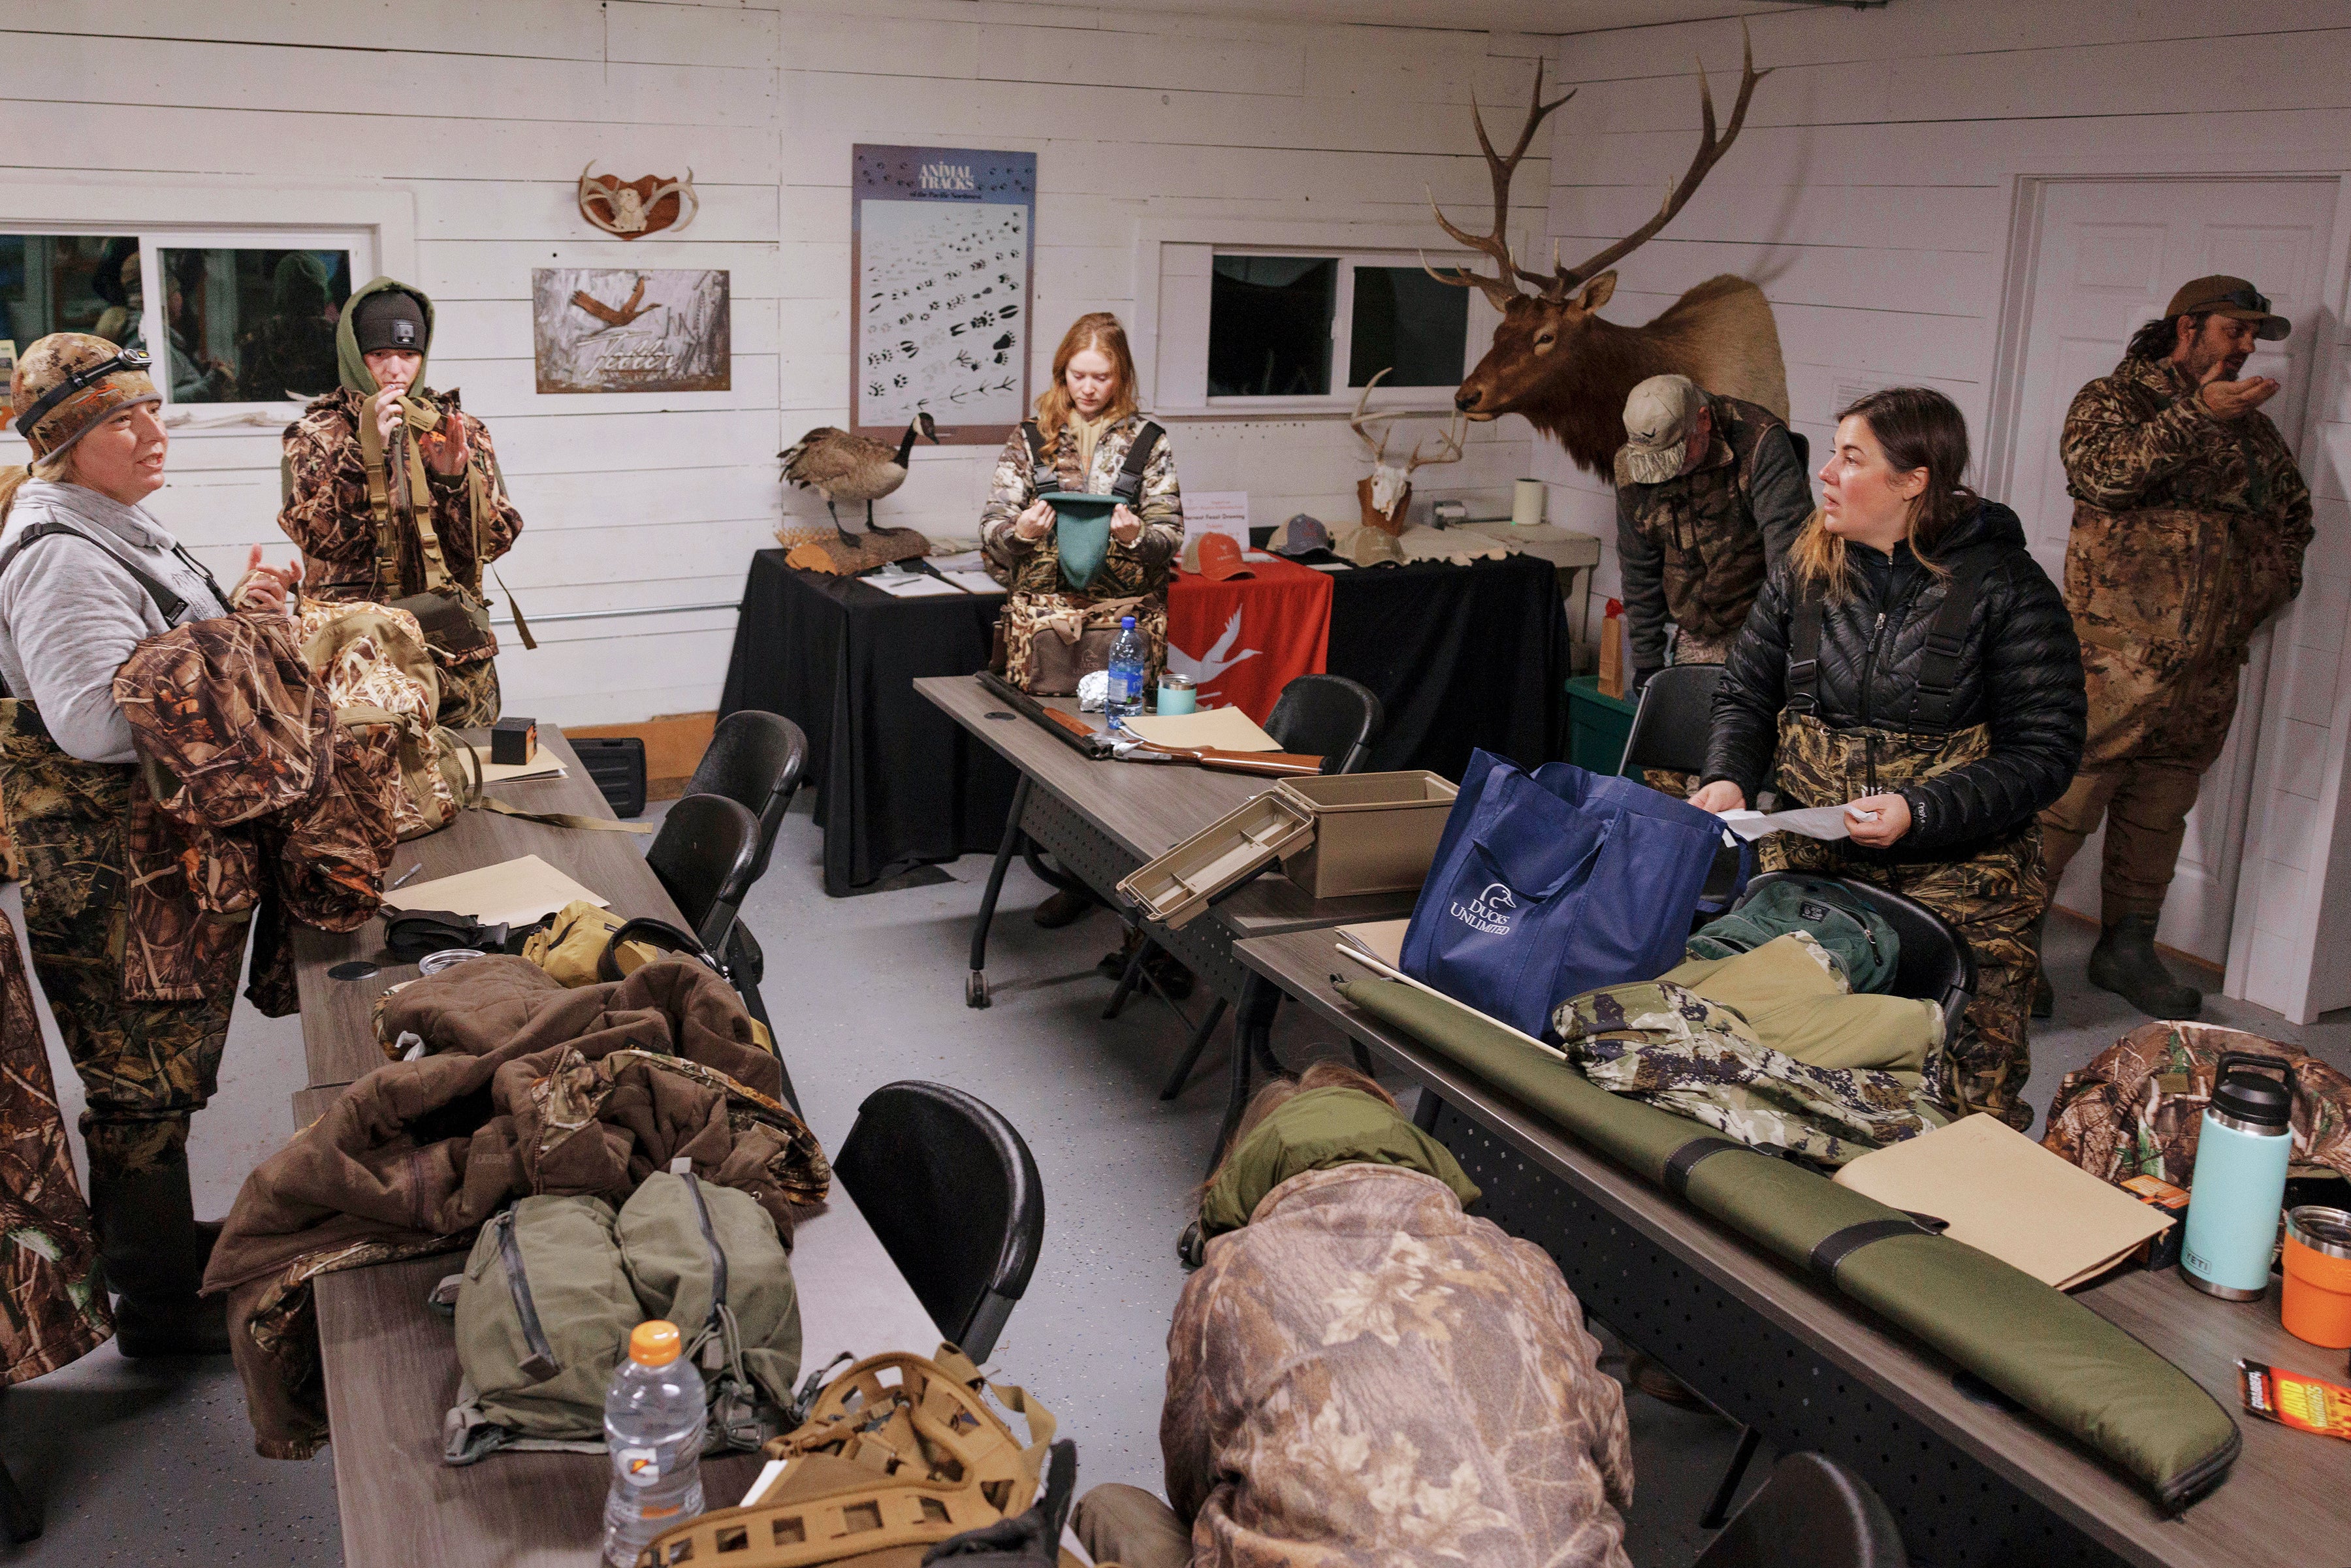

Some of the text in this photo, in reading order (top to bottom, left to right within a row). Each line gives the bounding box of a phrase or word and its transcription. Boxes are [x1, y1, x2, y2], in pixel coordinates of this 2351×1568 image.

[919, 161, 974, 179] ANIMAL
[920, 176, 974, 189] TRACKS
[1450, 902, 1511, 935] UNLIMITED
[1468, 899, 1511, 925] DUCKS
[2186, 1253, 2208, 1270] YETI
[2249, 1371, 2264, 1411] GRABBER
[2280, 1379, 2309, 1420] HAND
